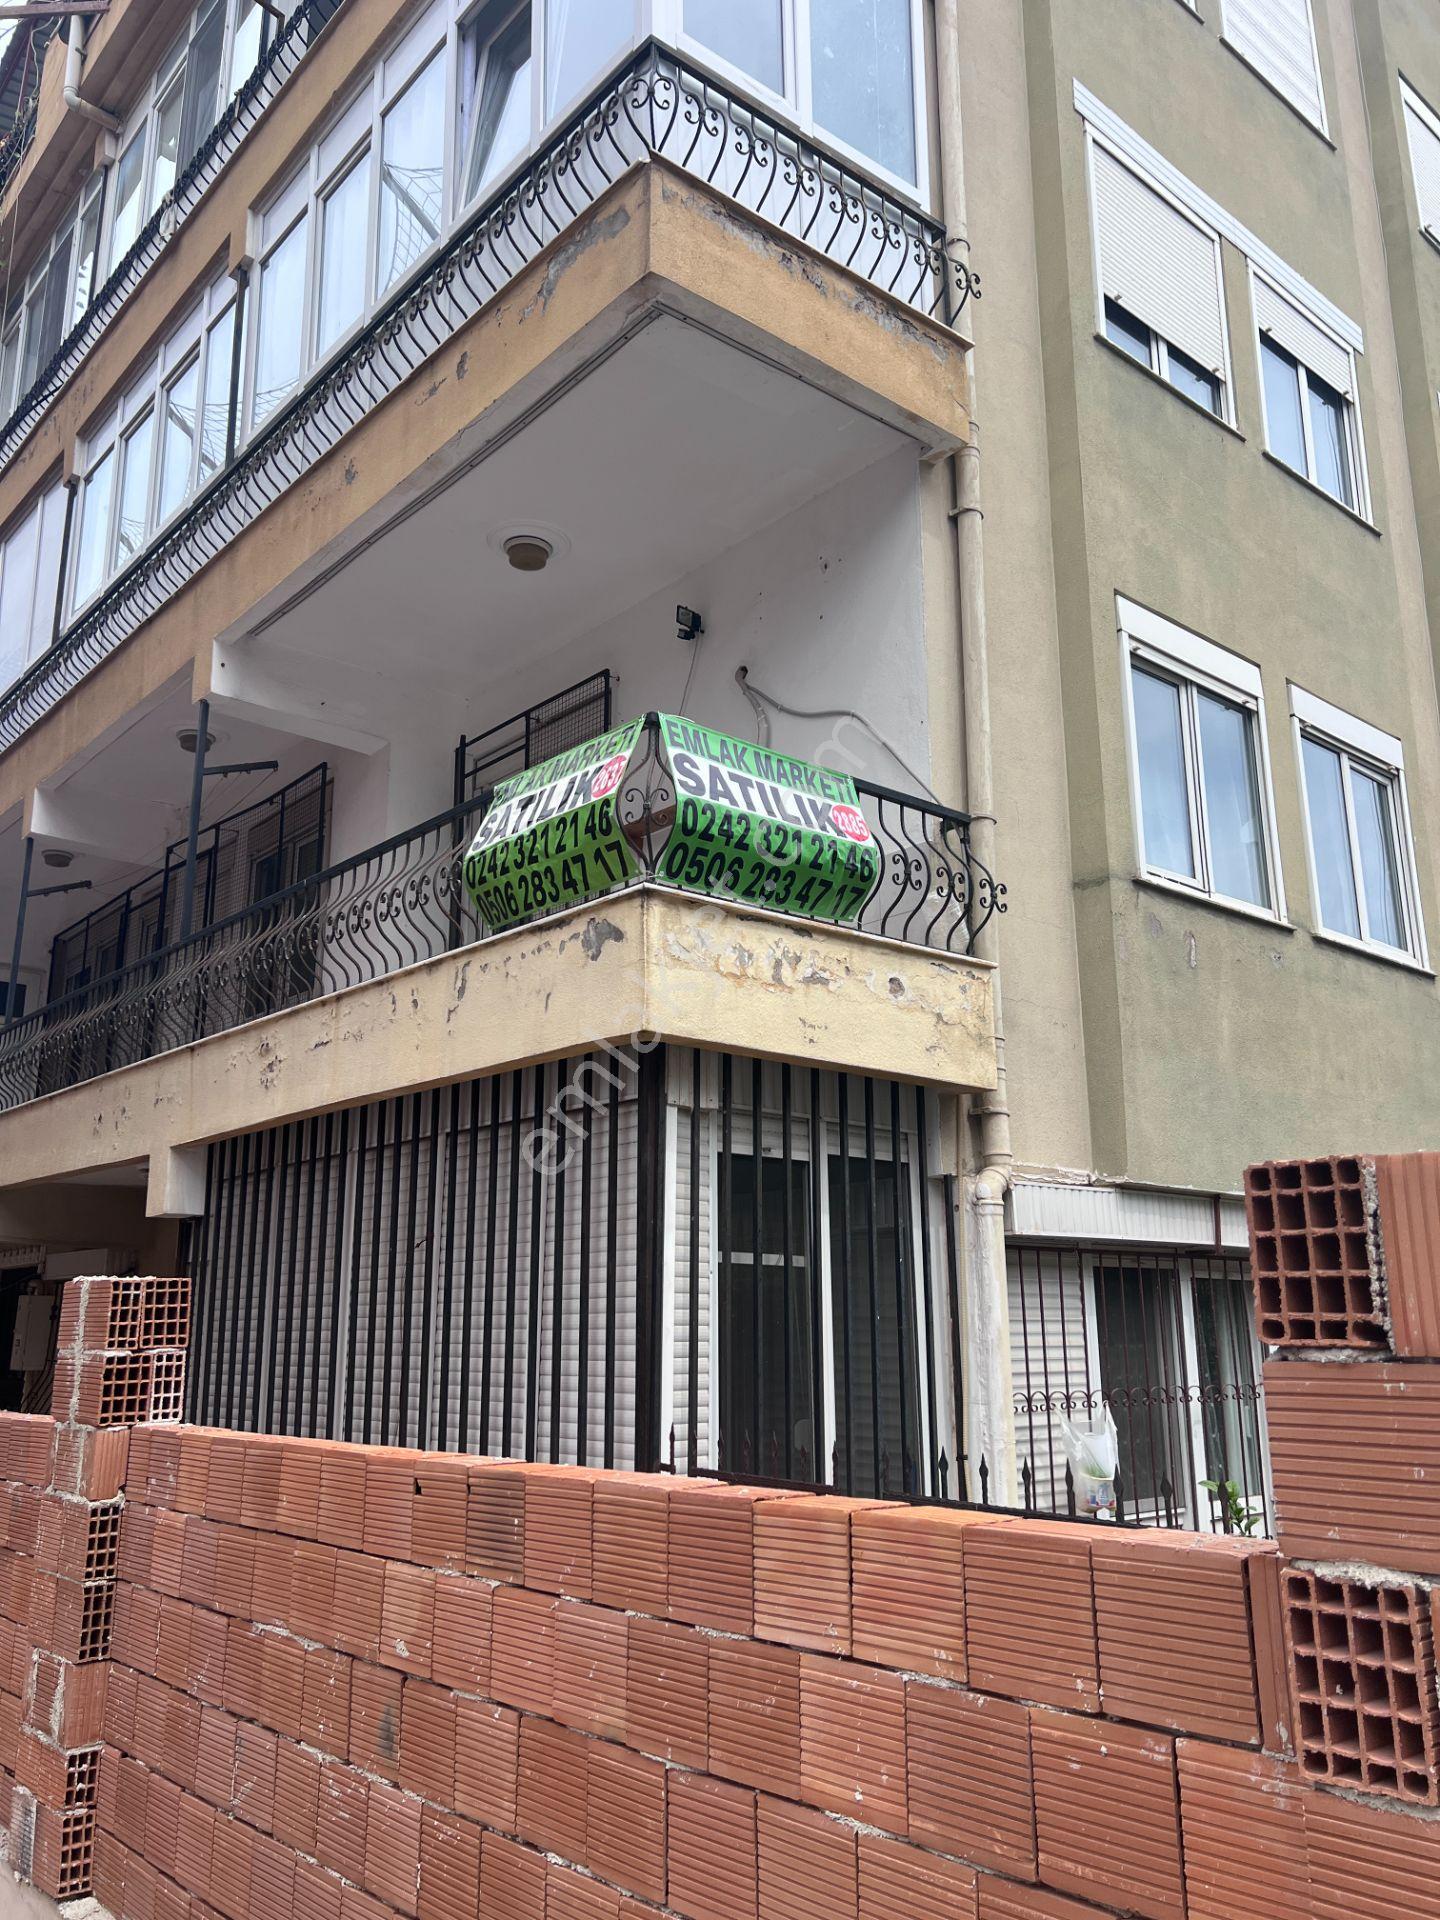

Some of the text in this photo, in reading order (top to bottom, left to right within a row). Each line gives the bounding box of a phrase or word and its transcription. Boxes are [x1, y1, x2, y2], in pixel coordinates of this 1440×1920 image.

[666, 721, 752, 774] EMLAK
[471, 764, 605, 850] SATILIK
[672, 753, 847, 837] SATILIK
[833, 811, 867, 837] 2885
[465, 799, 612, 889] 0242 321 21 46
[666, 842, 867, 918] 0506 283 47 17
[681, 798, 874, 883] 0242 321 21 46
[476, 840, 629, 926] 0506 283 47 17
